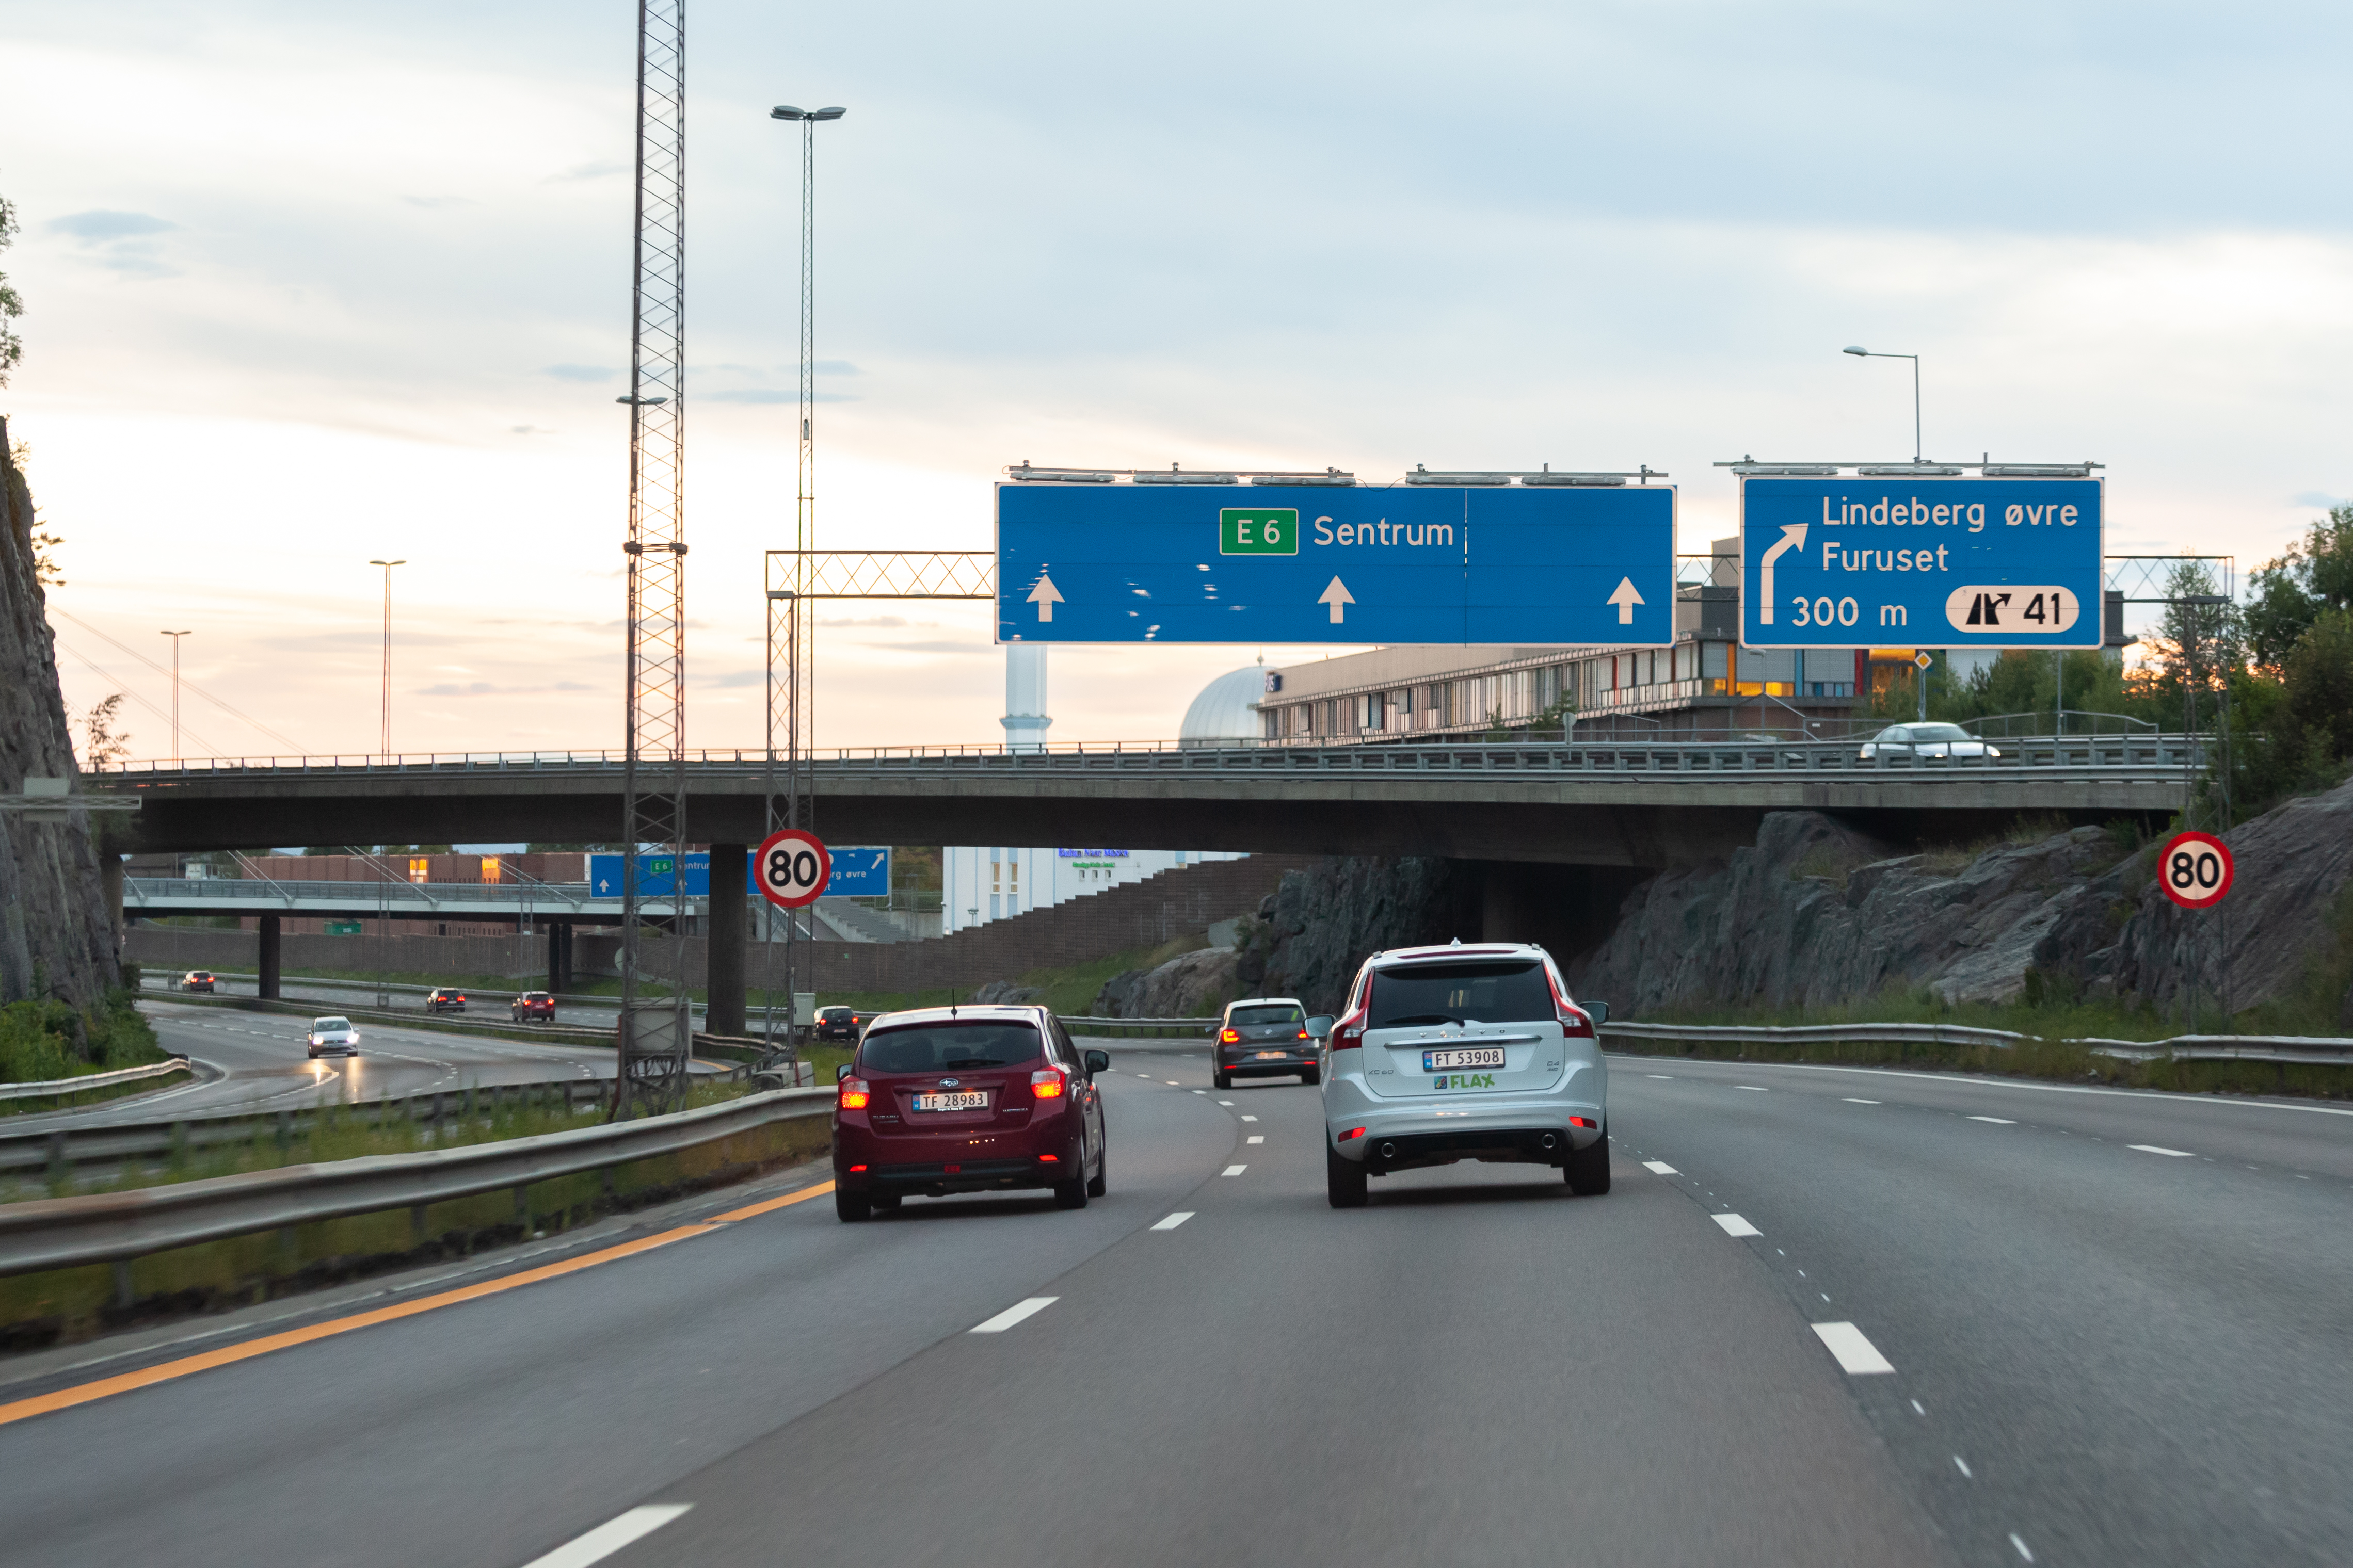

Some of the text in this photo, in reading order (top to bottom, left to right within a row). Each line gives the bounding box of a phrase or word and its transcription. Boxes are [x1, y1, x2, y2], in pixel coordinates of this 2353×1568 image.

[1823, 496, 2078, 532] Lindeberg øvre
[1238, 516, 1453, 545] E 6 Sentrum
[1823, 542, 1949, 572] Furuset
[1792, 596, 1907, 626] 300 m
[2024, 593, 2060, 625] 41
[768, 849, 818, 887] 80
[2171, 852, 2220, 889] 80
[1436, 1050, 1499, 1066] FT 53908
[1450, 1073, 1495, 1089] FLAX
[923, 1093, 984, 1108] TF 28983
